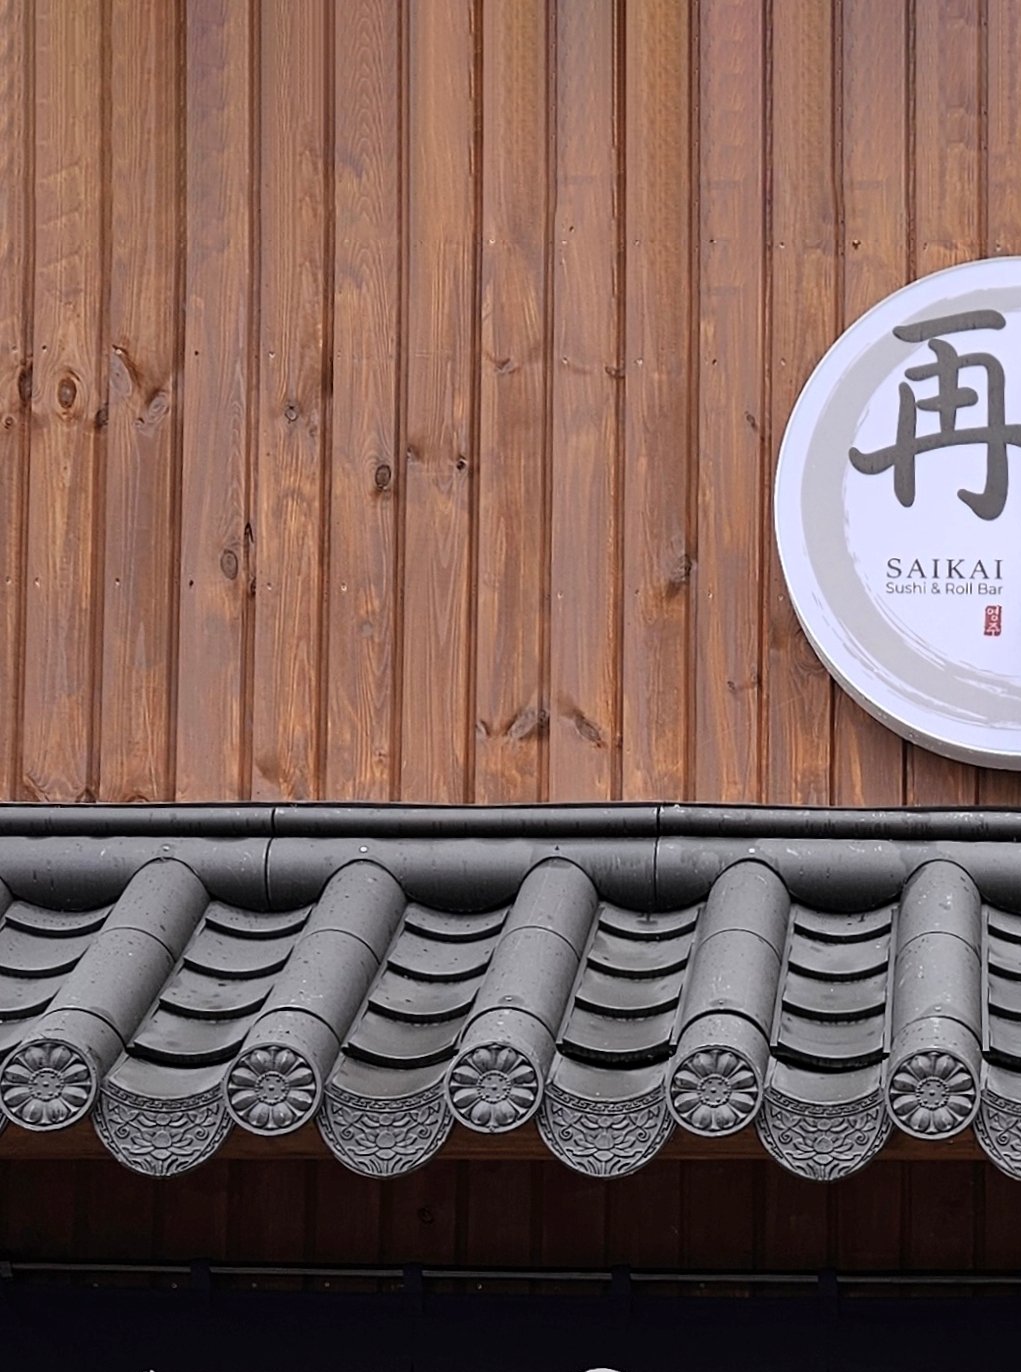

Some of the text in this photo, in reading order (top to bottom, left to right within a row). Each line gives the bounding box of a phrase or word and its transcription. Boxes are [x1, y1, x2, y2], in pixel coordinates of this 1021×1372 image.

[886, 557, 1003, 580] SAIKAI
[886, 582, 1004, 596] Sushi & Roll Bar
